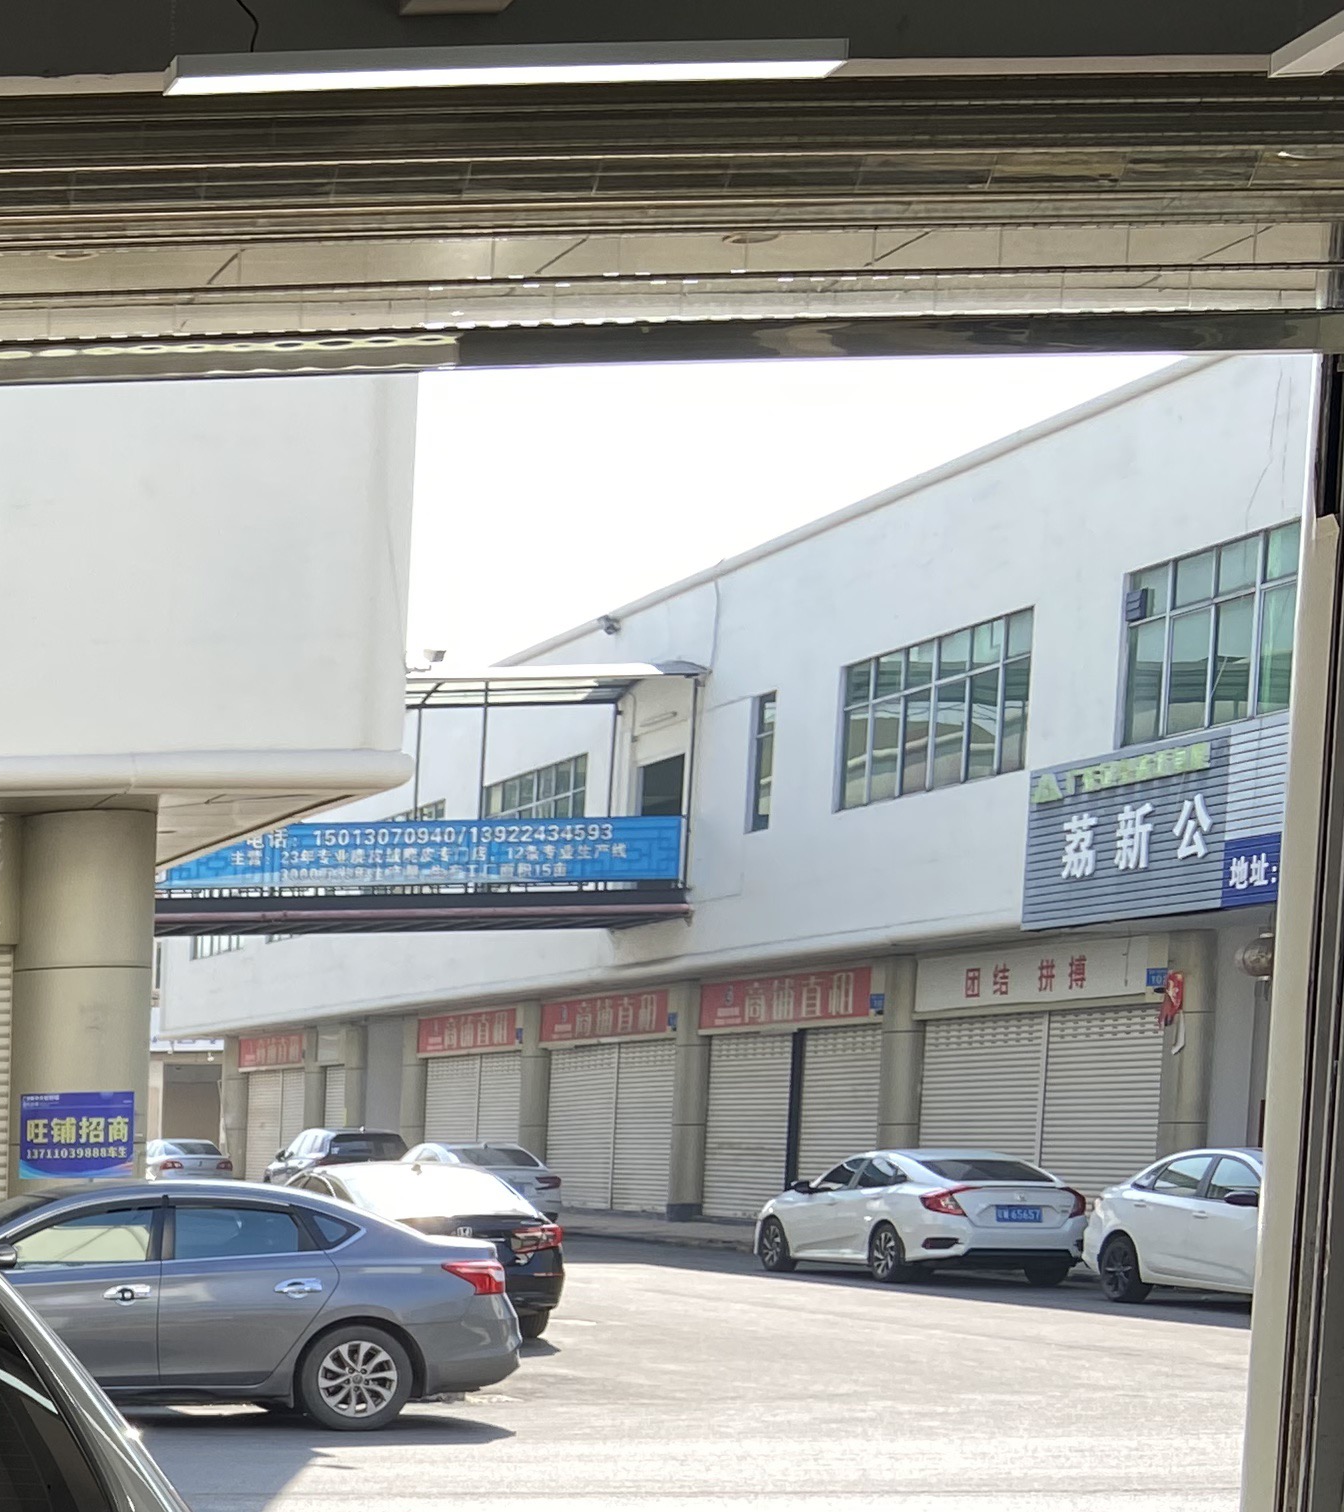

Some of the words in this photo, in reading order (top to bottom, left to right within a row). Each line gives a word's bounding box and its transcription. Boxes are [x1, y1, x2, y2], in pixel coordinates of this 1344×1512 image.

[1062, 793, 1213, 880] 荔新公
[964, 964, 1011, 998] 团结
[1037, 953, 1088, 993] 拼搏
[26, 1116, 129, 1144] 旺铺招商
